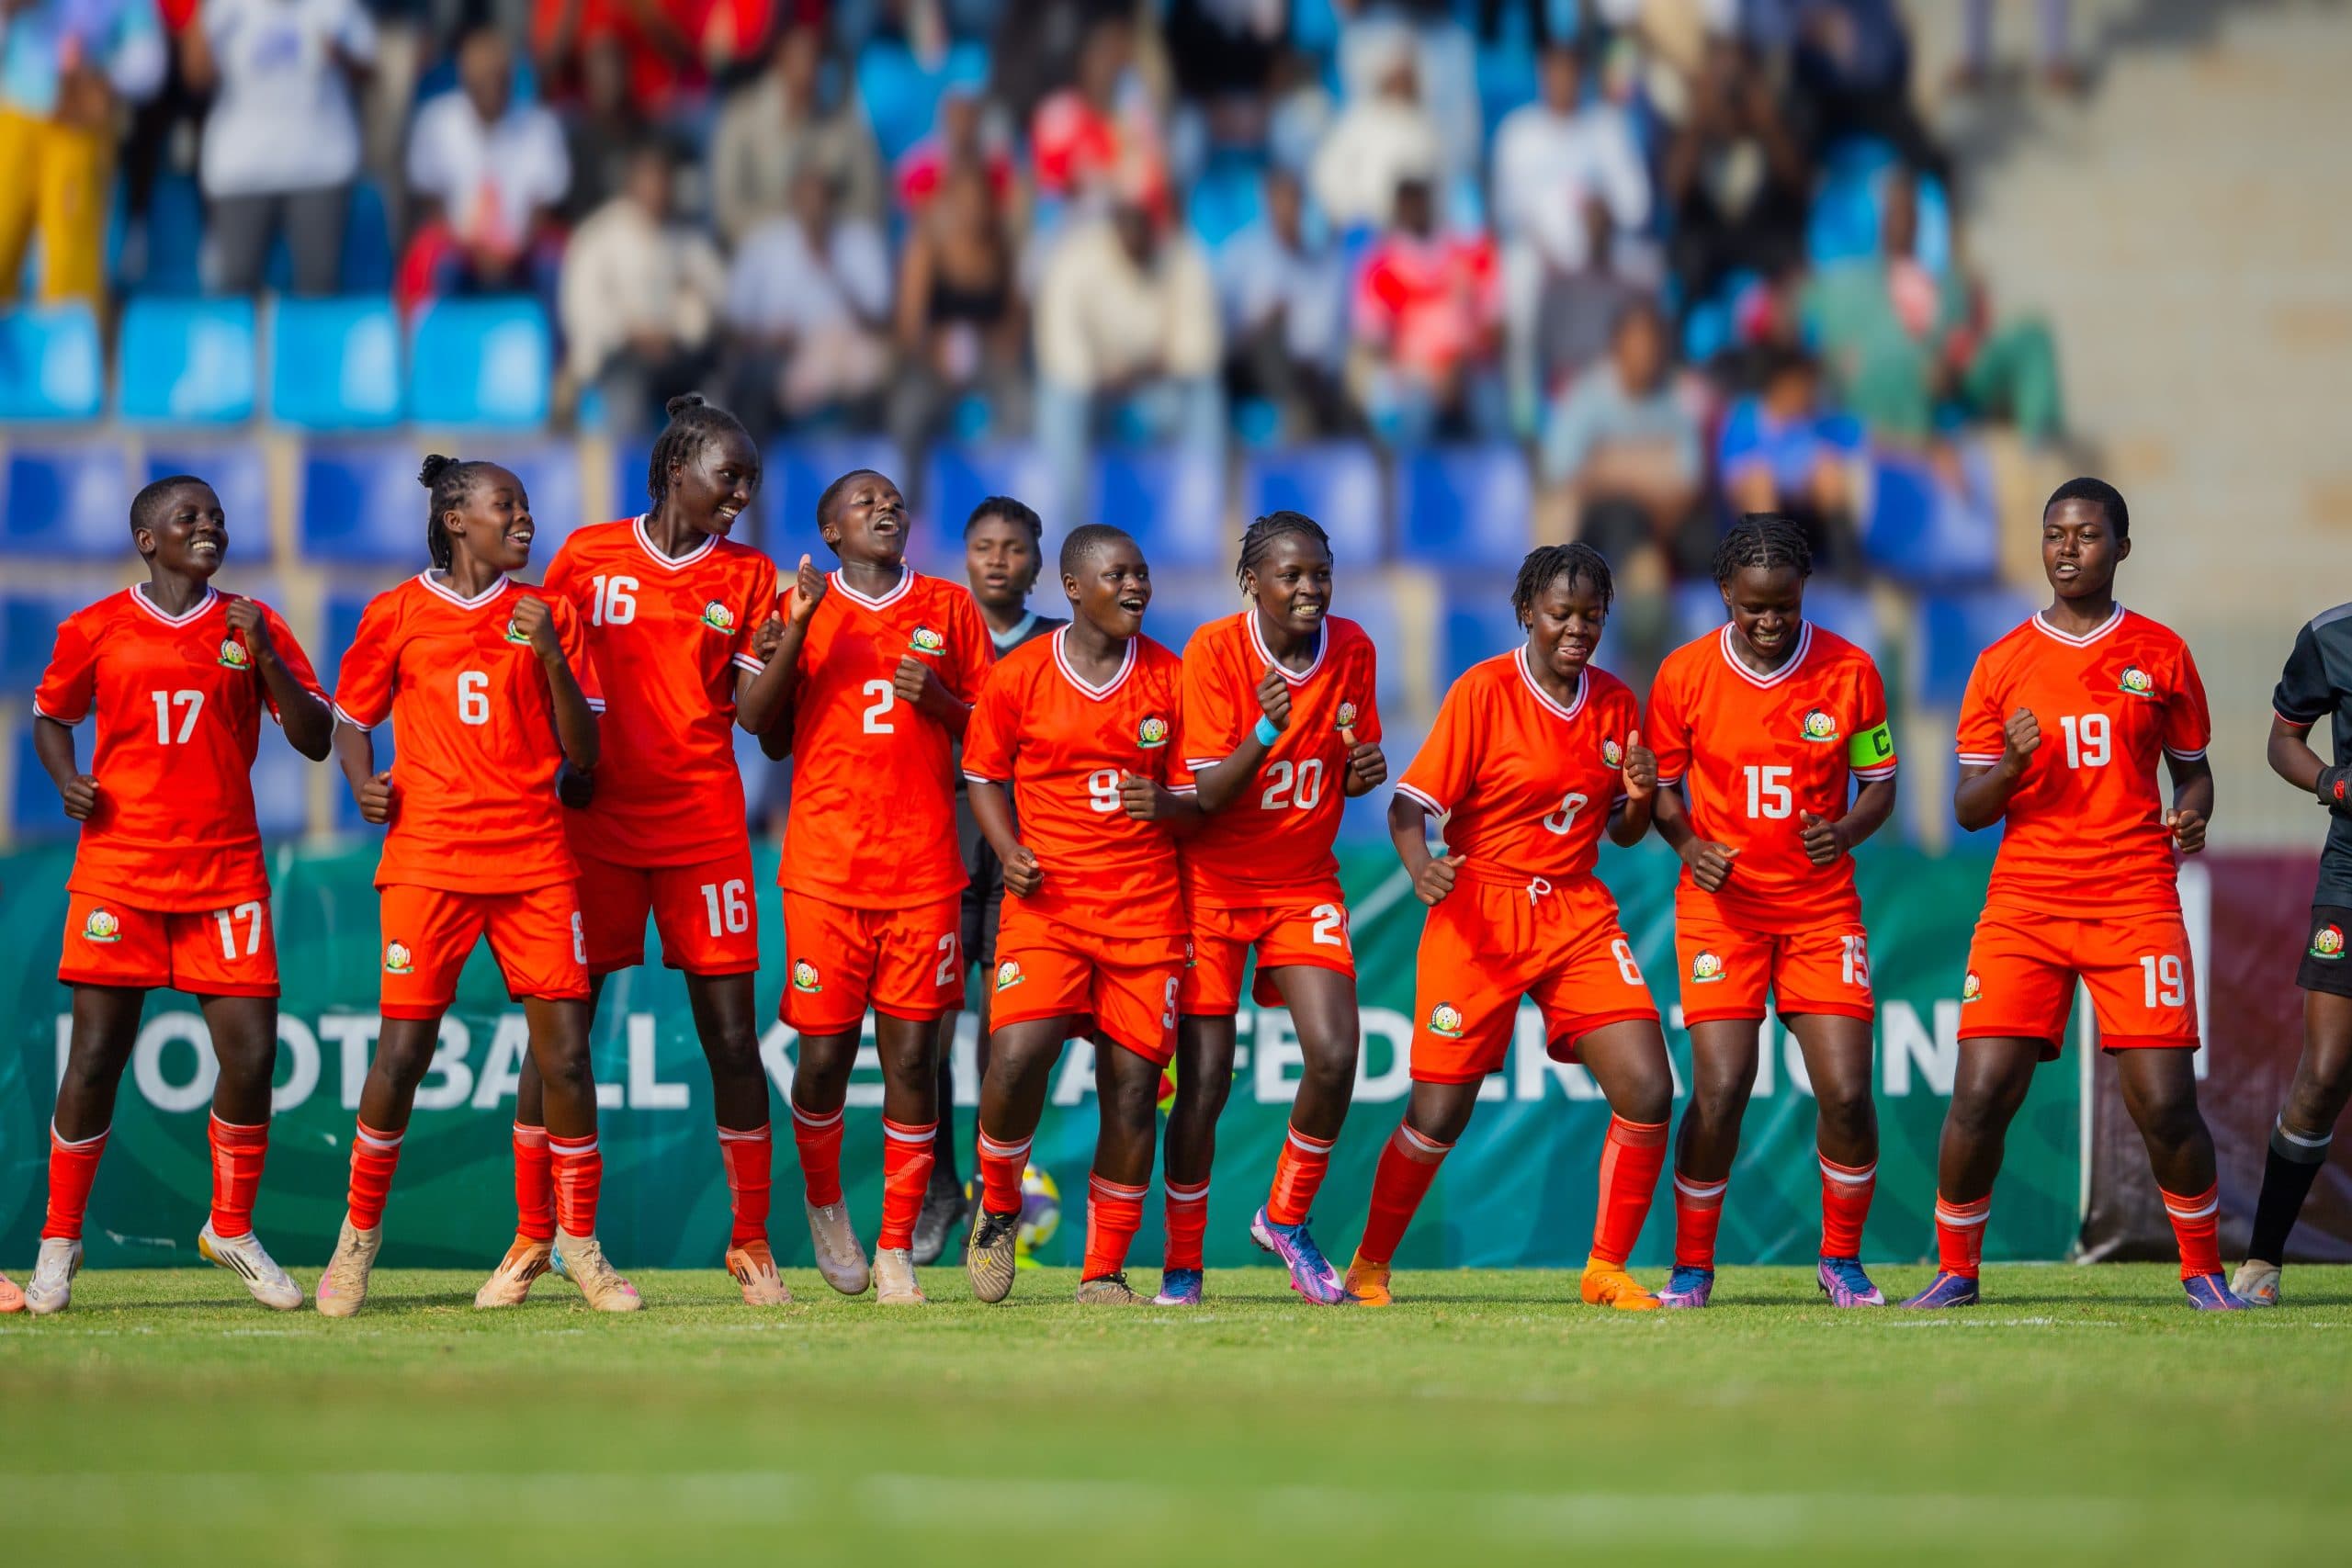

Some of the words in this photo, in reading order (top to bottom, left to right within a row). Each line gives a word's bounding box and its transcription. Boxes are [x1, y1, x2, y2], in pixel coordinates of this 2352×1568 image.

[592, 575, 639, 626] 16
[153, 690, 205, 745] 17
[458, 671, 490, 726] 6
[863, 679, 894, 734] 2
[1872, 728, 1891, 756] C
[2061, 713, 2111, 769] 19
[1089, 769, 1121, 813] 9
[1261, 759, 1323, 810] 20
[1744, 765, 1792, 819] 15
[1543, 792, 1589, 836] 8
[215, 901, 262, 960] 17
[701, 880, 749, 937] 16
[936, 931, 956, 987] 2
[1611, 939, 1645, 986] 8
[2140, 954, 2186, 1009] 19
